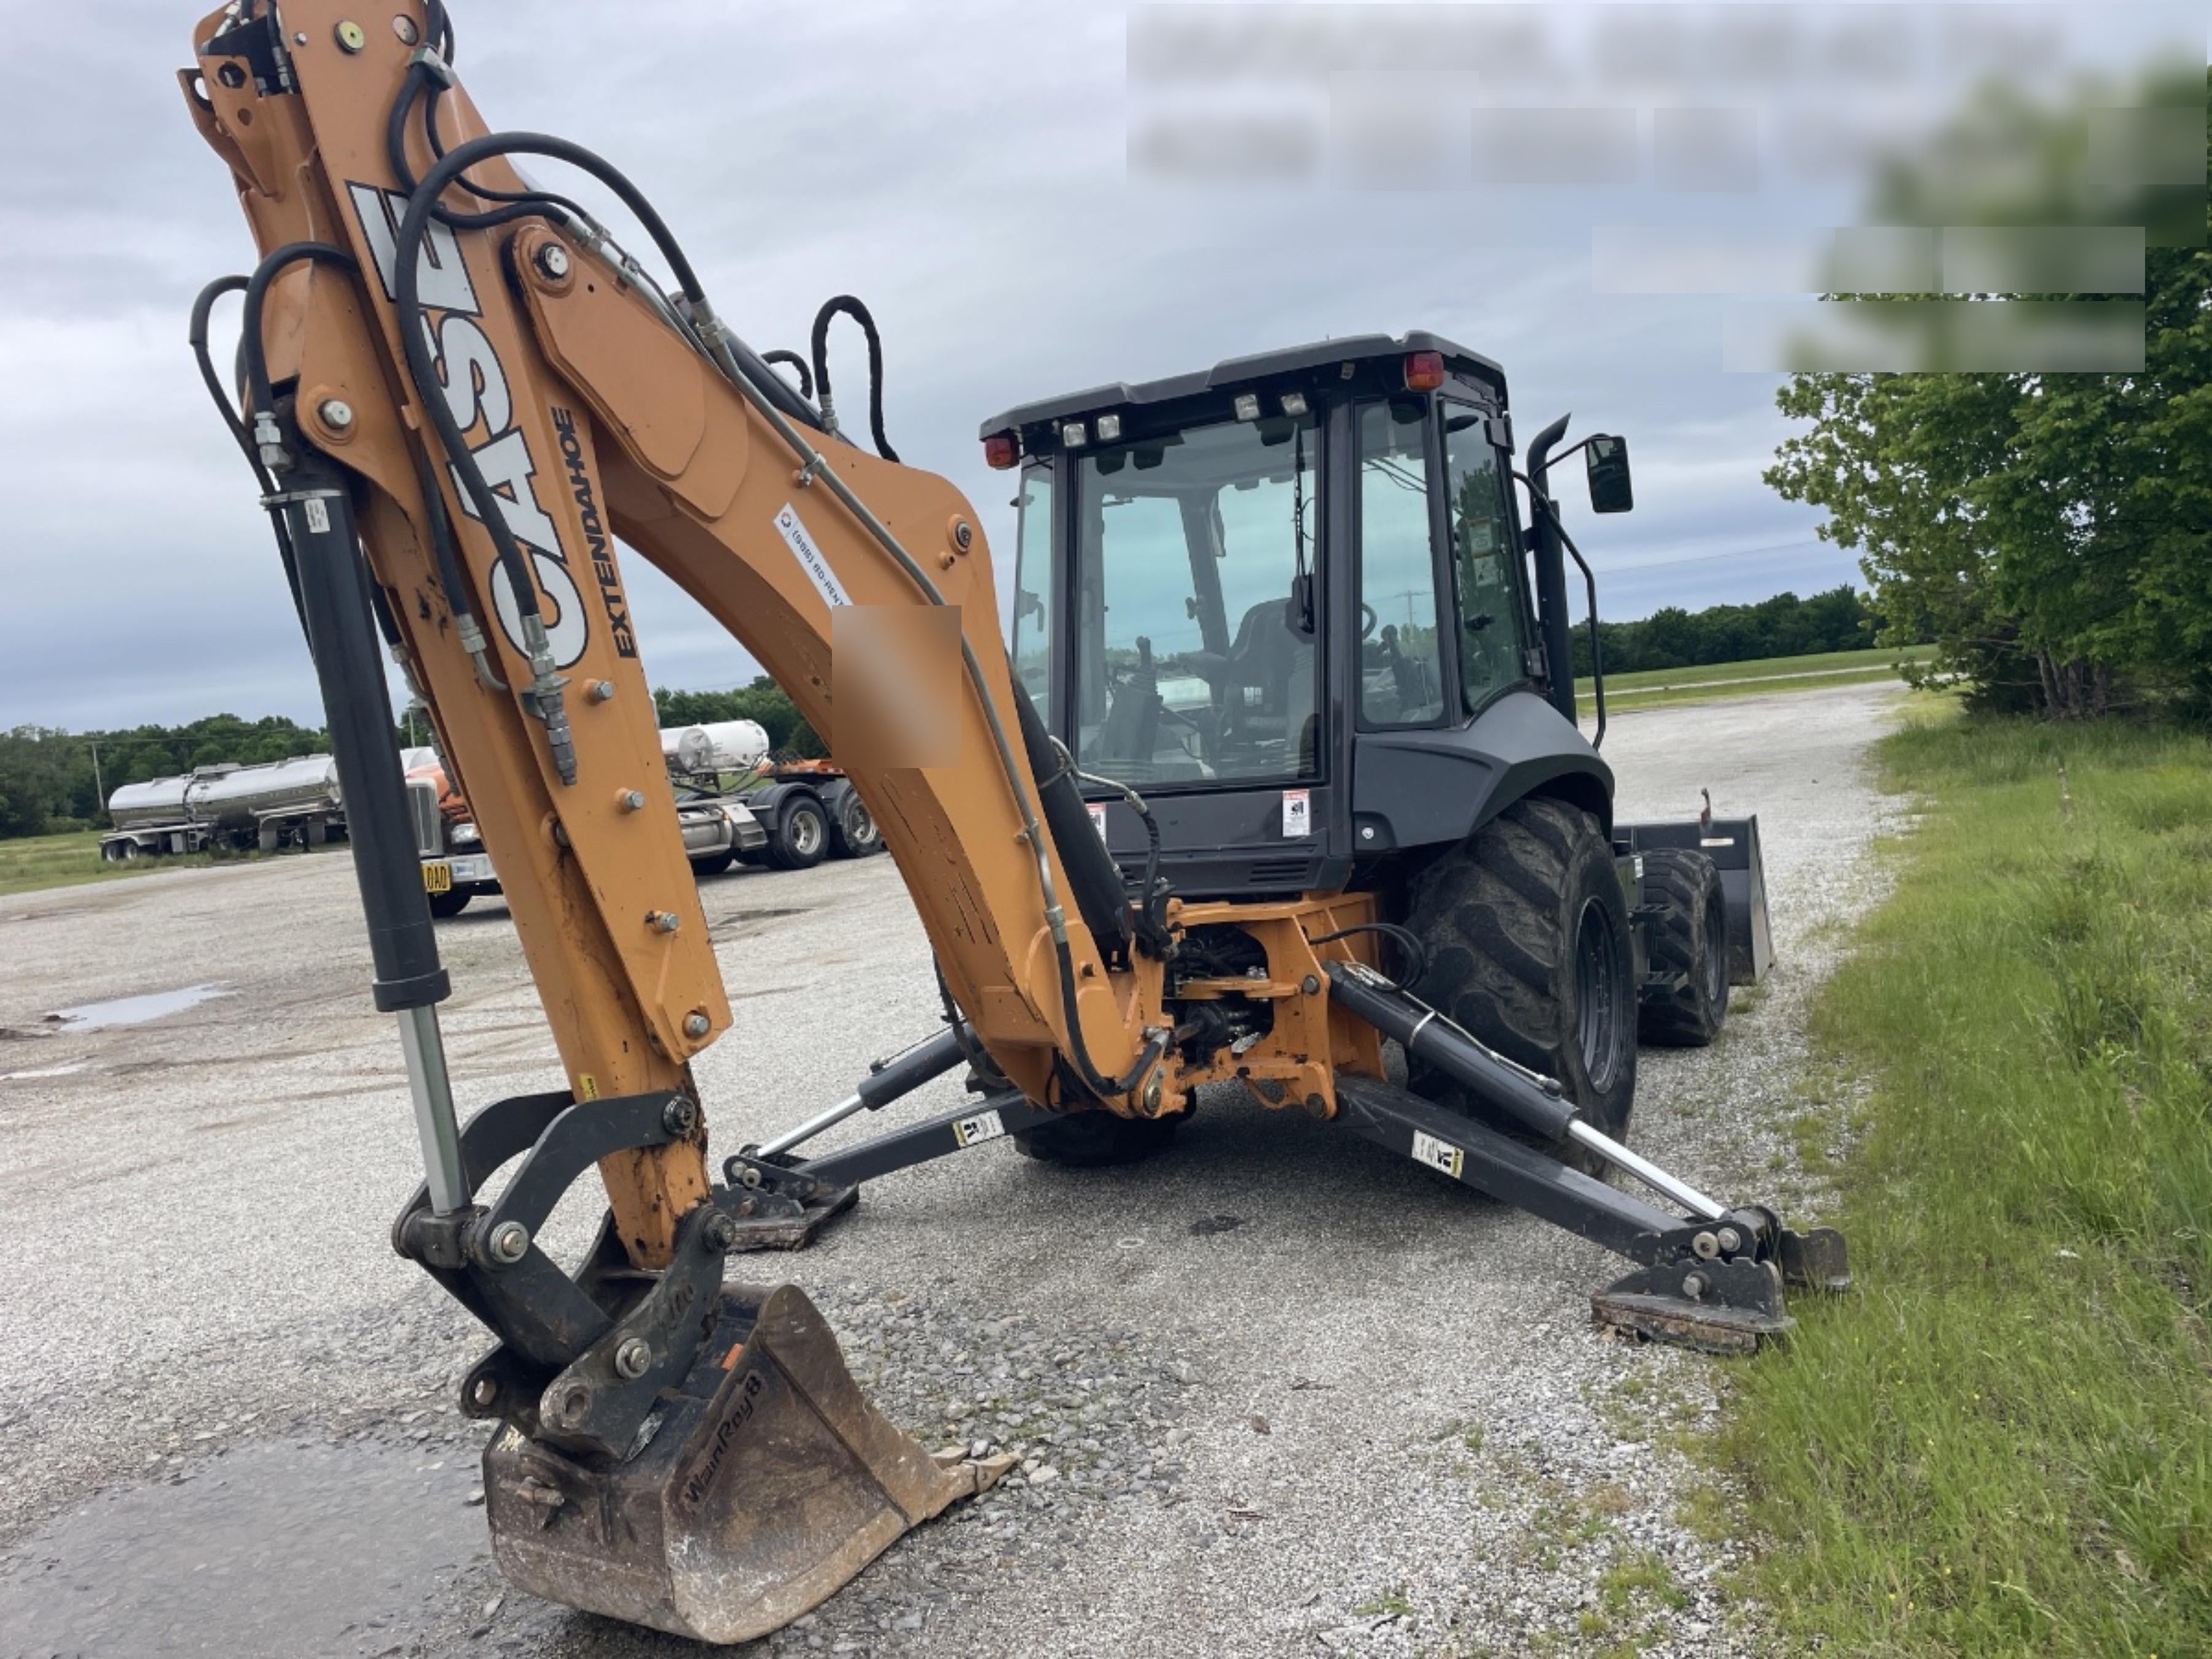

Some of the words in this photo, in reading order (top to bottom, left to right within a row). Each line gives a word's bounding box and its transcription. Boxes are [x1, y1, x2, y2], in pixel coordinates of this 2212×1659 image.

[345, 180, 588, 669] CASE
[551, 406, 637, 659] EXTENDAHOE
[426, 866, 447, 889] OAD
